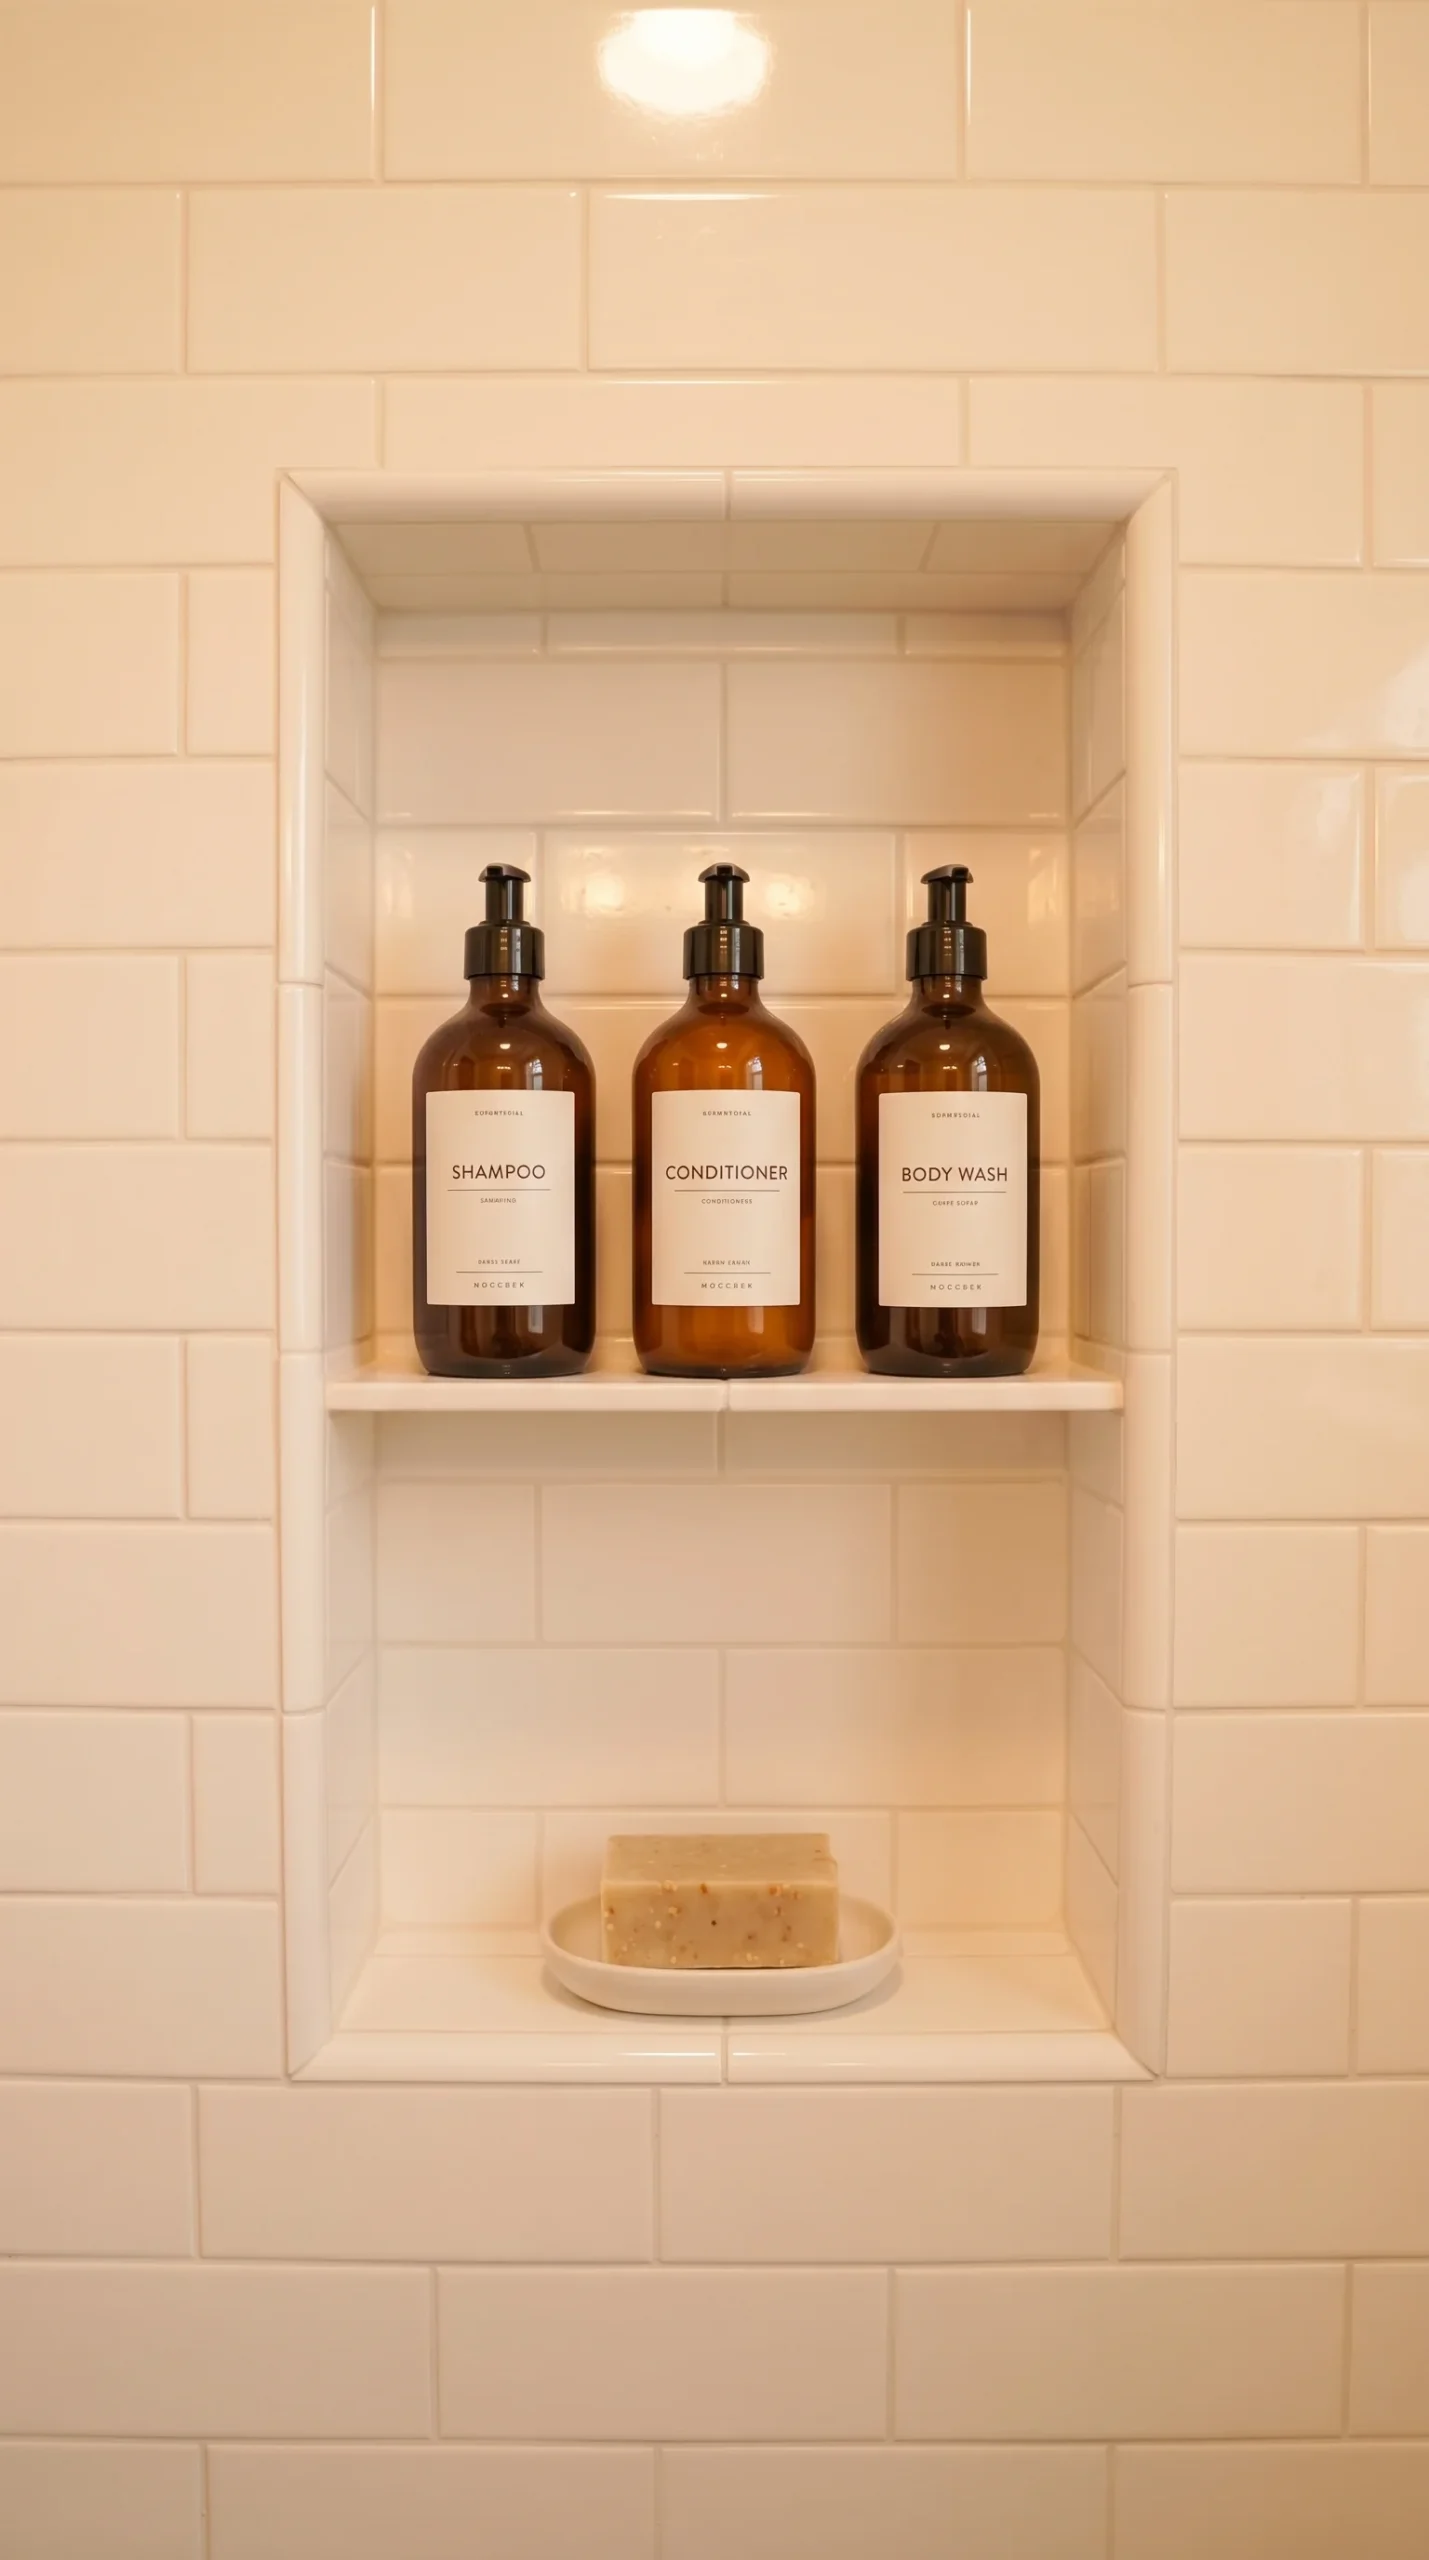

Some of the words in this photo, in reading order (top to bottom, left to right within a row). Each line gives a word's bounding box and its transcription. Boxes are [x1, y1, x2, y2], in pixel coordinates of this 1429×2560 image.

[452, 1164, 546, 1180] SHAMPOO
[665, 1165, 788, 1180] CONDITIONER
[901, 1166, 953, 1182] BODY
[958, 1166, 1008, 1182] WASH
